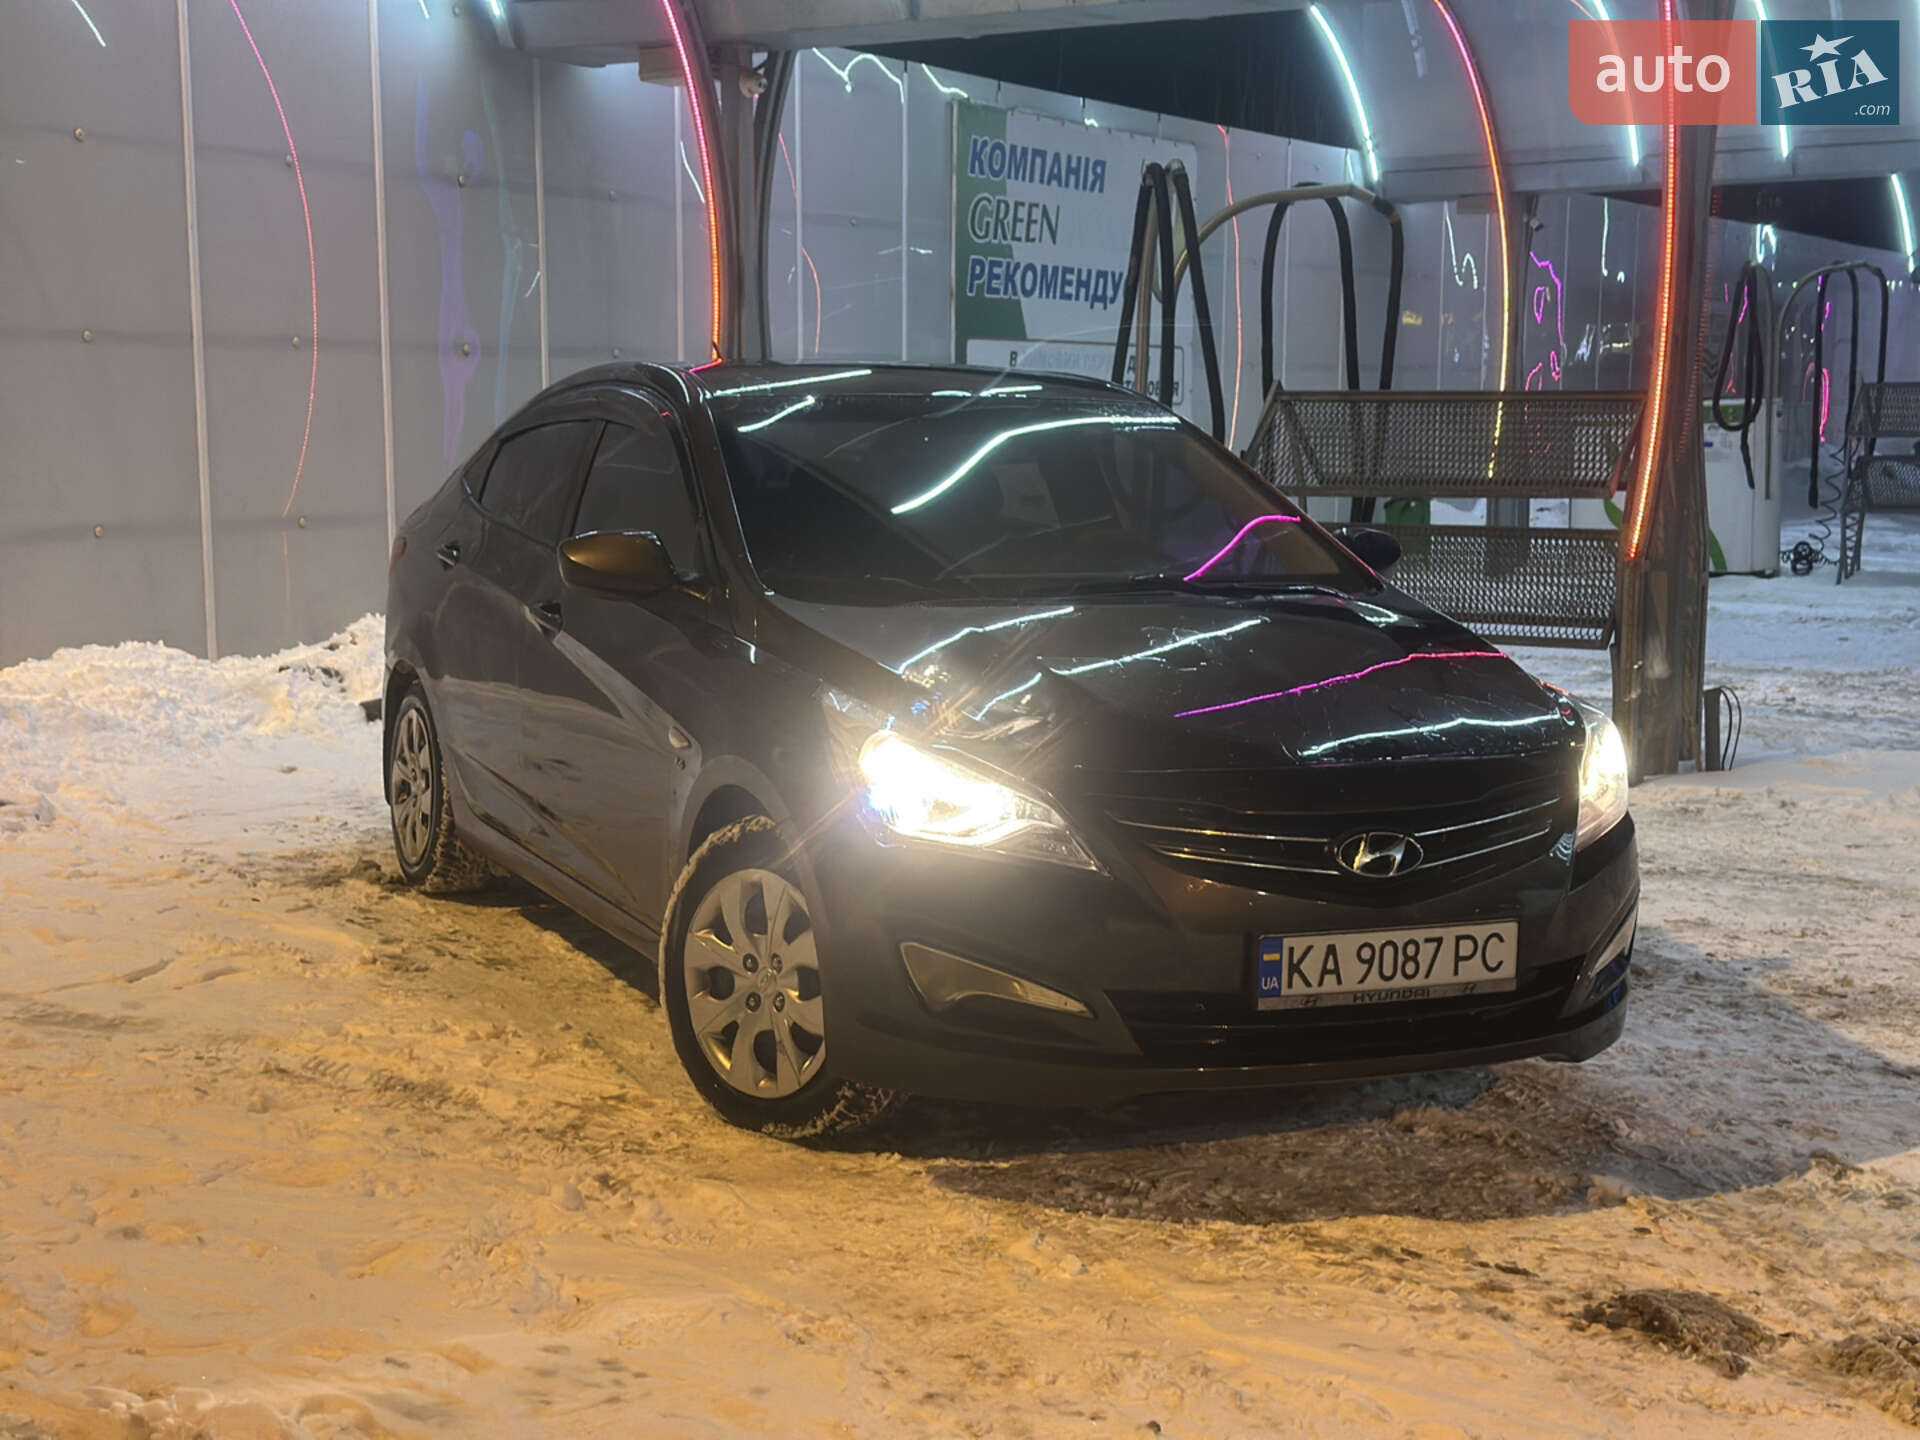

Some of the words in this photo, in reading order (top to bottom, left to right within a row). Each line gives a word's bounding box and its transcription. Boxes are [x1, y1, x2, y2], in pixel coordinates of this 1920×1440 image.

[968, 136, 1107, 193] КОМПАНІЯ
[969, 195, 1060, 245] GREEN
[967, 257, 1128, 310] РЕКОМЕНДУ
[1261, 976, 1279, 989] UA
[1287, 943, 1343, 989] KA
[1356, 936, 1444, 985] 9087
[1453, 932, 1505, 977] PC
